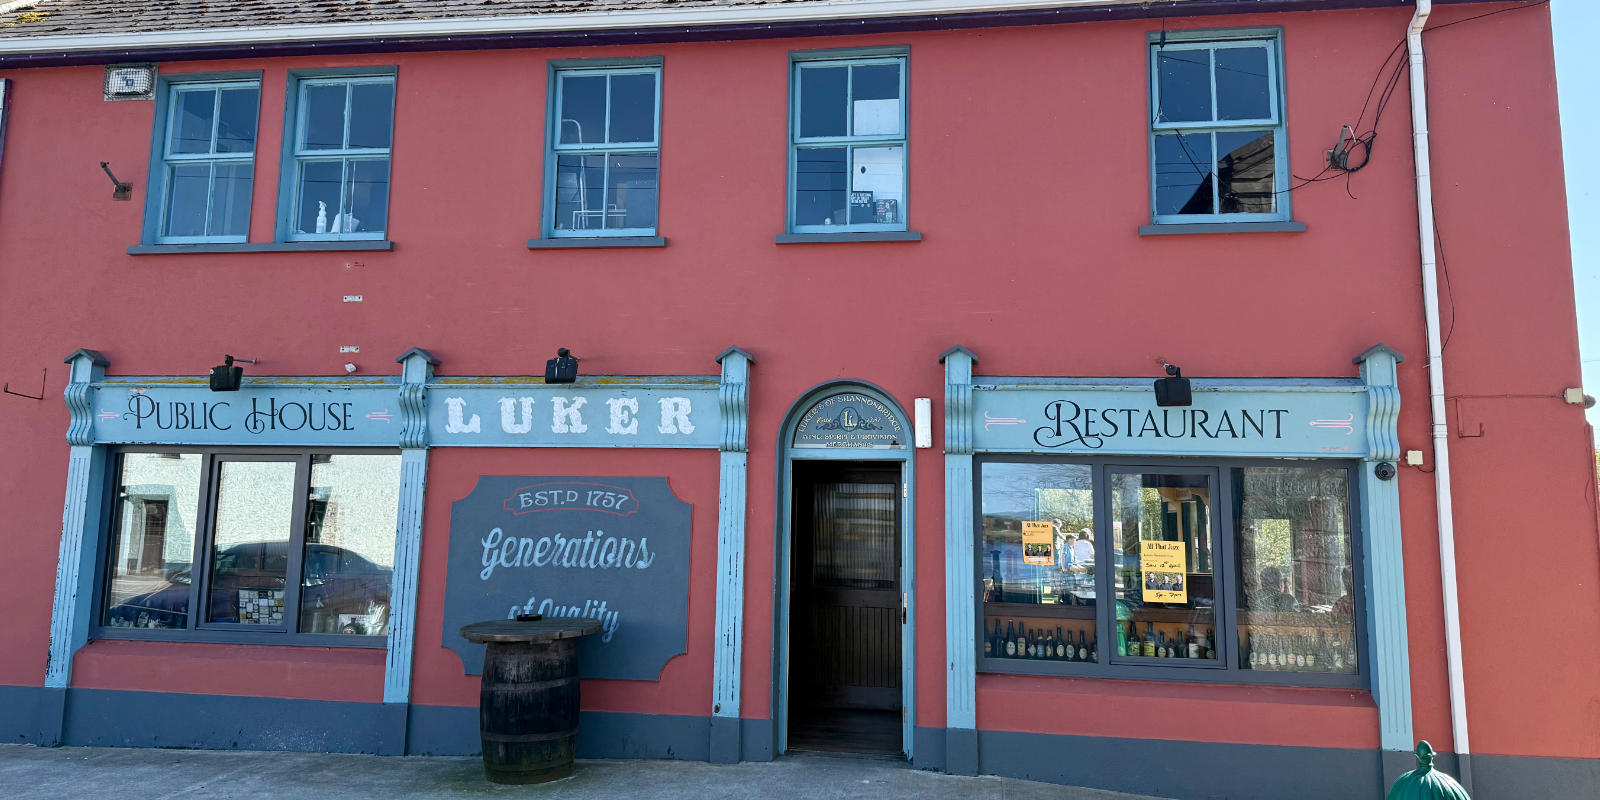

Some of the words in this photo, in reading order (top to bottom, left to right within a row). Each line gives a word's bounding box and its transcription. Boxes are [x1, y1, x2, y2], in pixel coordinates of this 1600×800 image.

[444, 396, 696, 435] LUKER
[825, 399, 836, 407] OF
[838, 395, 901, 432] SHANNONBRIDGE
[1033, 400, 1290, 448] RESTAURANT
[586, 490, 630, 510] 1757
[480, 527, 656, 580] Generations
